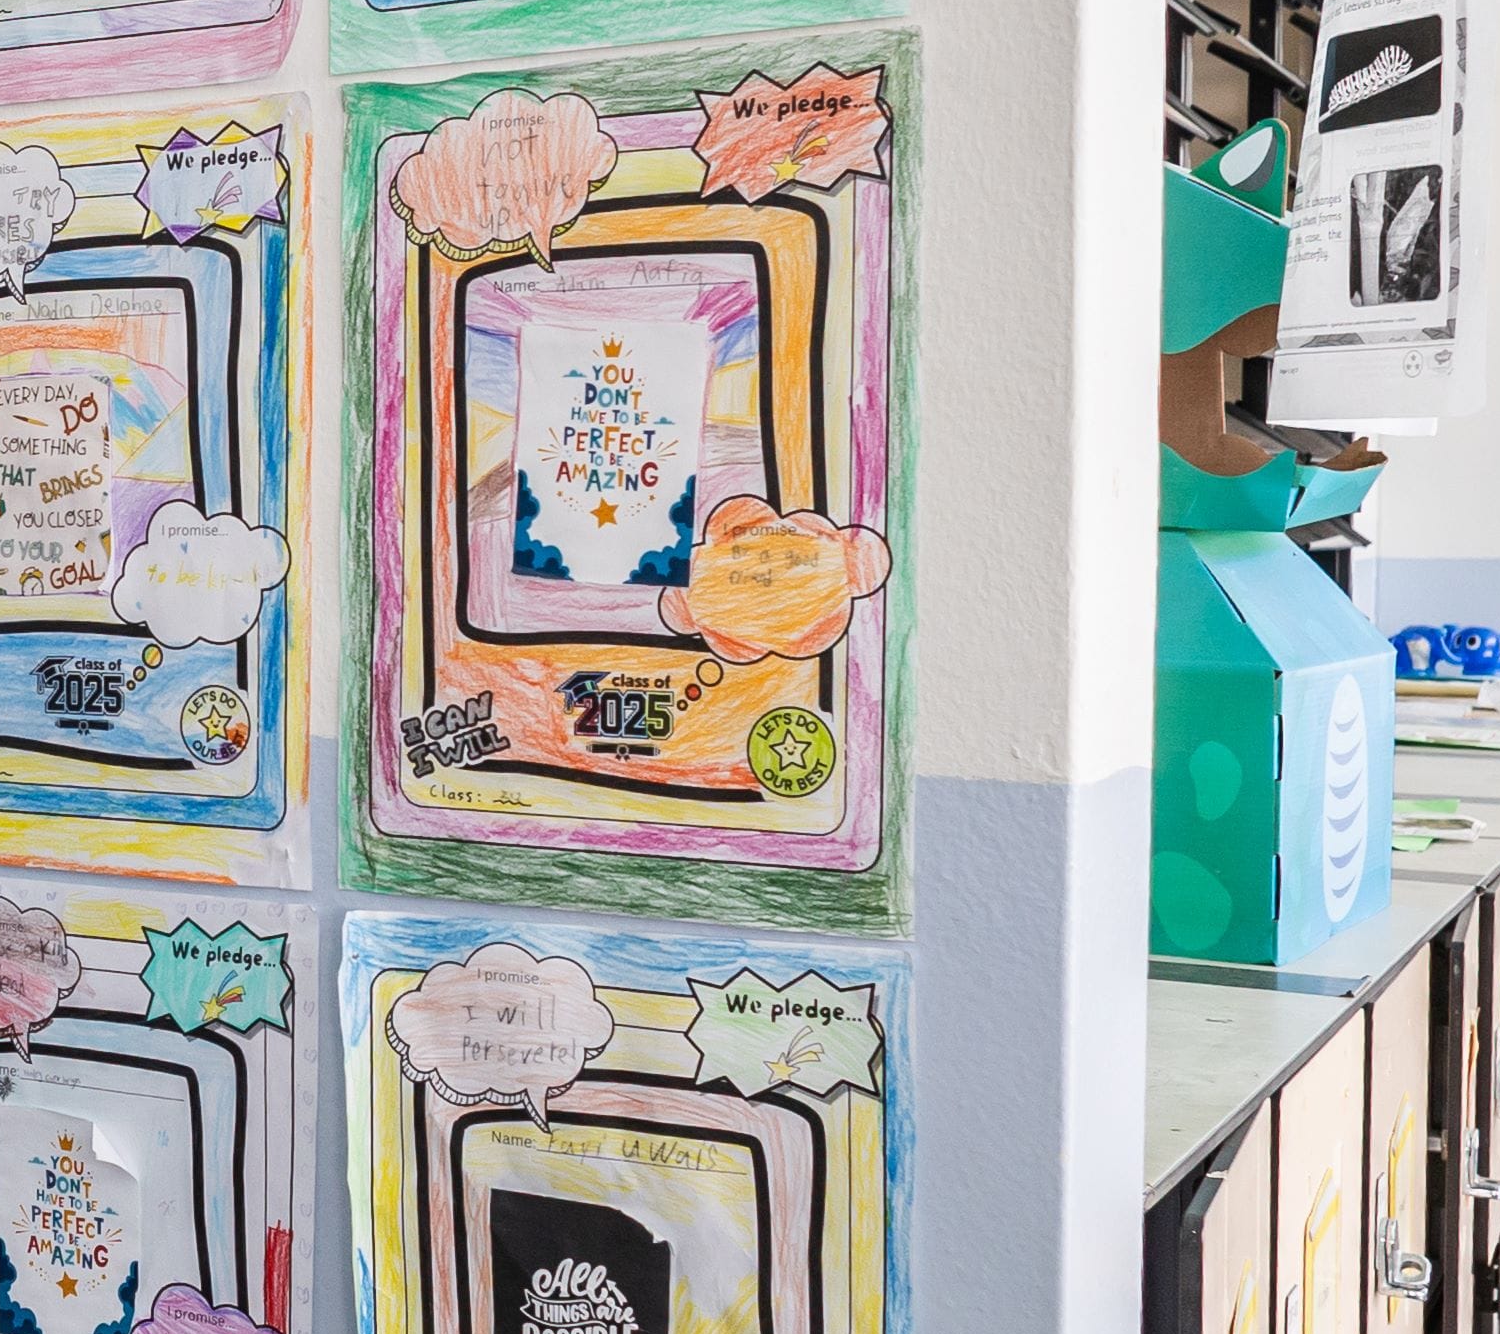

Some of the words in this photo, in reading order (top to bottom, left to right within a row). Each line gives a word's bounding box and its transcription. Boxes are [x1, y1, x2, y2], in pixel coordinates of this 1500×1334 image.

[733, 98, 769, 120] We
[778, 90, 870, 120] pledge...
[592, 364, 635, 383] YOU
[584, 382, 643, 408] DON'T
[60, 393, 98, 435] DO
[570, 407, 607, 424] HAVE
[612, 409, 629, 424] TO
[634, 409, 648, 425] BE
[0, 437, 87, 455] SOMETHING
[563, 427, 656, 456] PERFECT
[40, 464, 103, 504] BRINGS
[556, 461, 660, 492] AMAZING
[14, 513, 45, 529] YOU
[47, 508, 103, 529] CLOSER
[45, 674, 126, 716] 2025
[574, 689, 674, 738] 2025
[724, 994, 762, 1017] We
[770, 997, 862, 1024] pledge...
[50, 1156, 84, 1175] YOU
[45, 1169, 92, 1199] DON'T
[30, 1205, 104, 1239] PERFECT
[27, 1236, 109, 1269] AMAZING
[532, 1258, 607, 1301] All
[533, 1302, 589, 1324] THINGS
[596, 1302, 635, 1324] are
